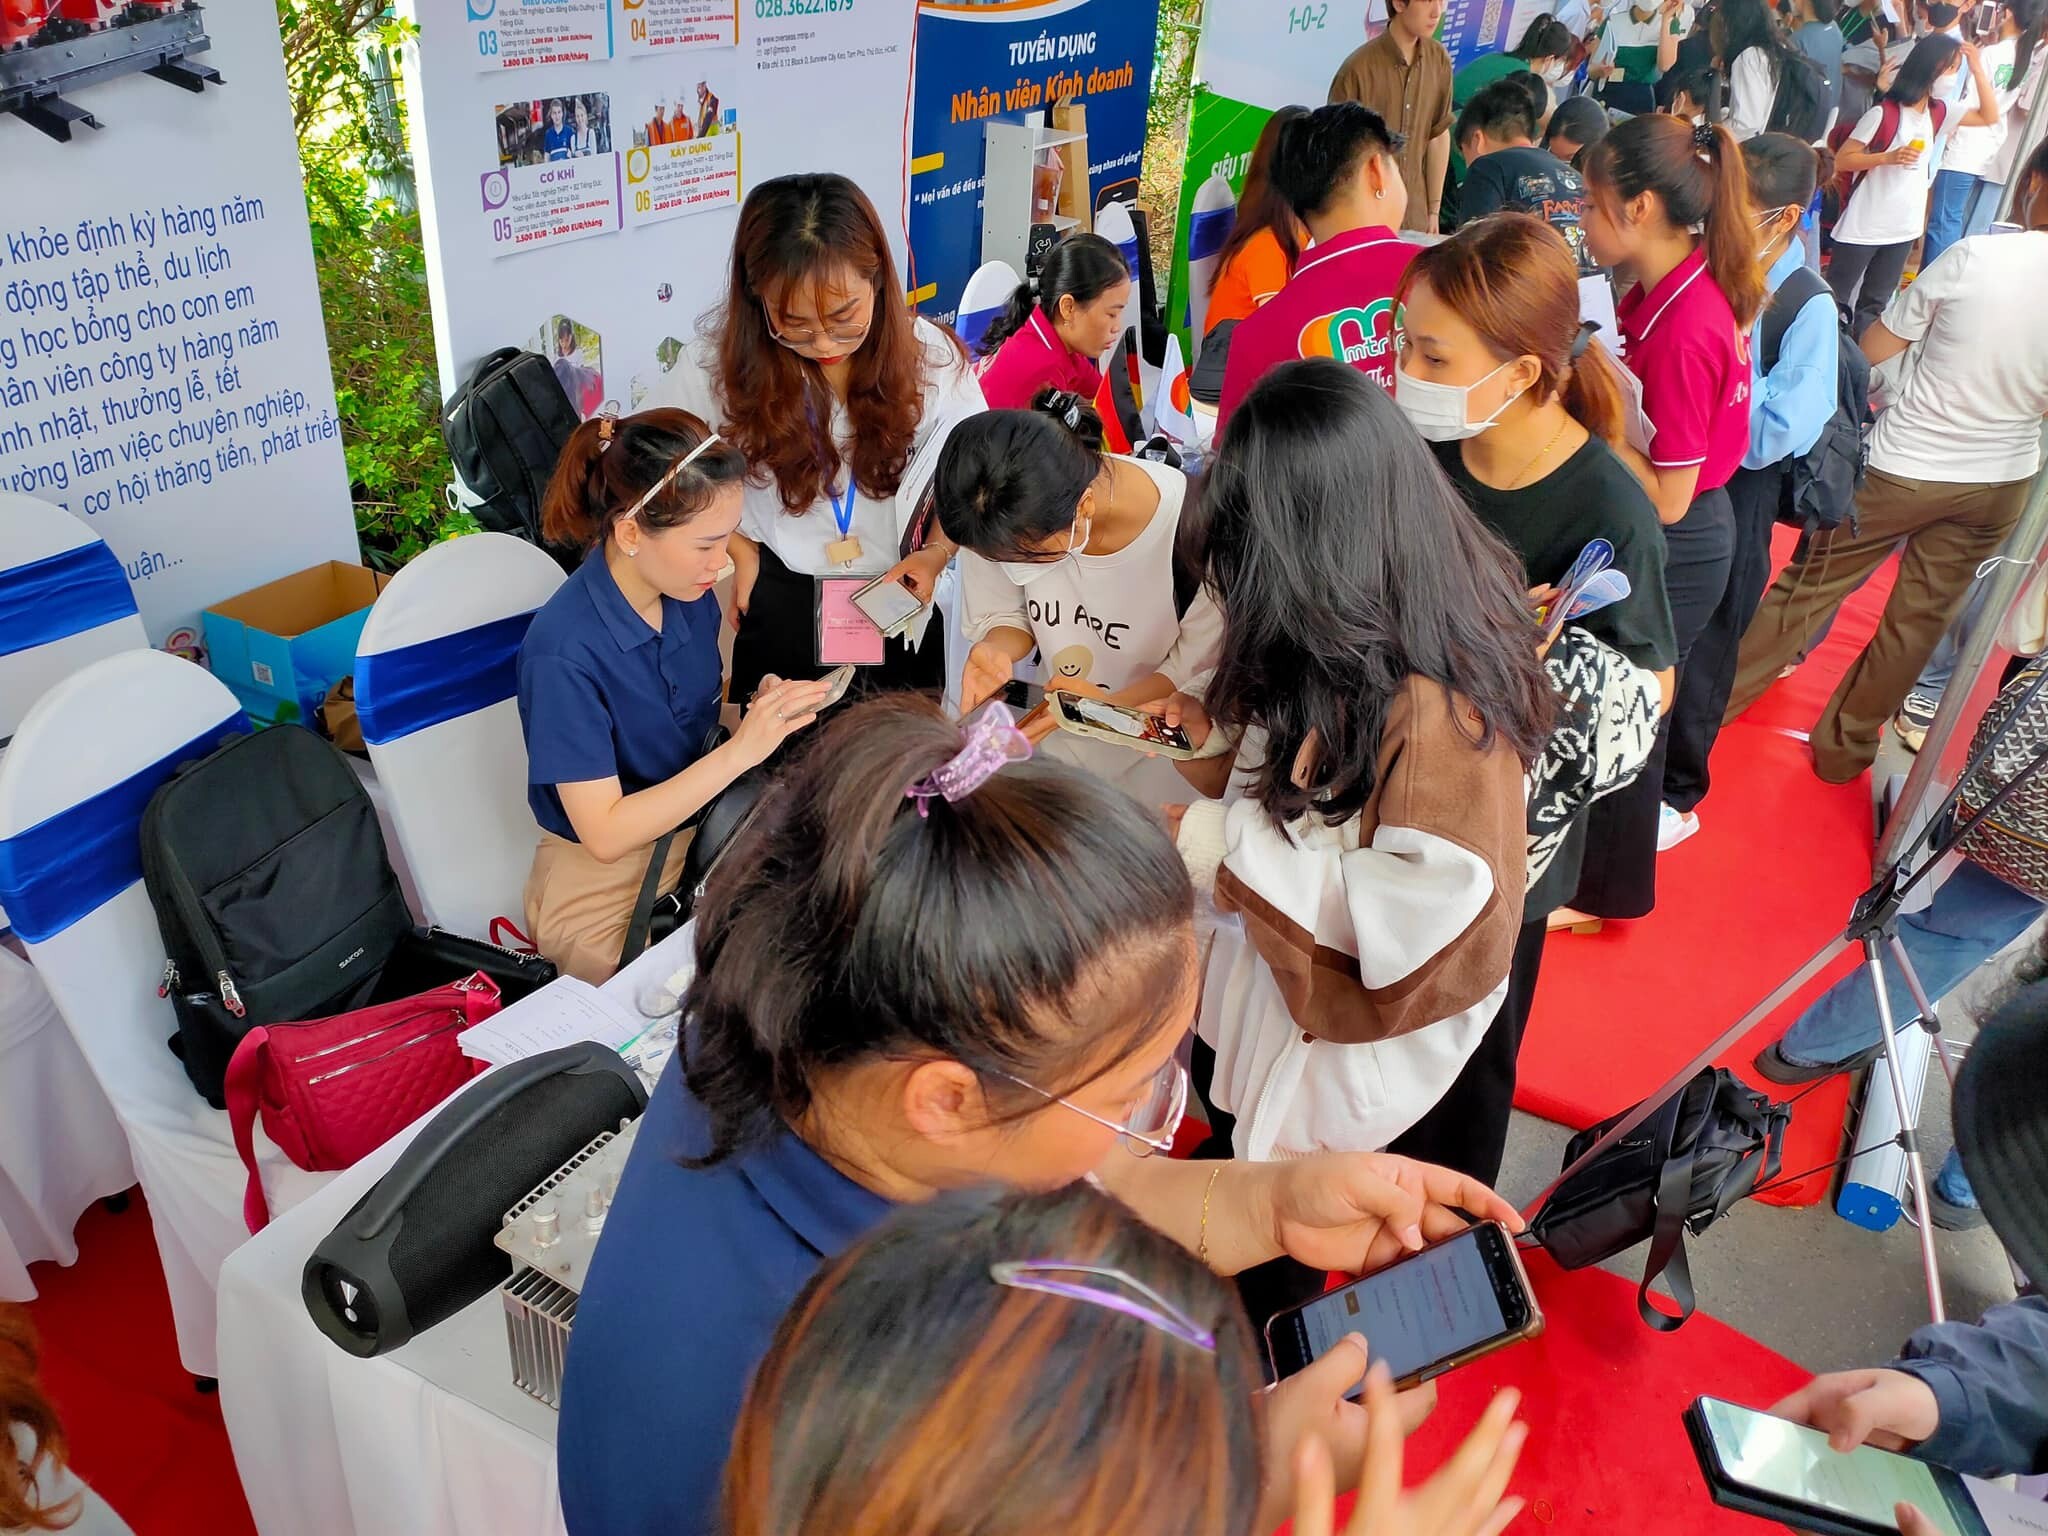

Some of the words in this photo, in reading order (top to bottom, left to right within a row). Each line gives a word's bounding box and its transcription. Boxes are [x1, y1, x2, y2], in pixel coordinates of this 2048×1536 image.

[631, 17, 647, 42] 04
[1289, 3, 1328, 34] 1-0-2
[478, 30, 498, 55] 03
[1008, 29, 1056, 66] TUYỂN
[1057, 31, 1097, 63] DỤNG
[951, 86, 1001, 124] Nhân
[1005, 78, 1041, 111] viên
[1045, 69, 1083, 104] Kinh
[1086, 60, 1134, 95] doanh
[540, 169, 555, 183] CƠ
[557, 165, 576, 181] KHÍ
[636, 190, 651, 212] 06
[7, 226, 69, 264] khỏe
[77, 217, 126, 252] định
[130, 210, 155, 248] kỳ
[162, 205, 216, 236] hàng
[221, 195, 264, 226] năm
[493, 216, 512, 242] 05
[534, 230, 547, 240] EUR
[6, 280, 68, 315] động
[72, 268, 109, 303] tập
[115, 251, 158, 290] thể,
[164, 251, 191, 280] du
[197, 242, 232, 279] lịch
[21, 328, 68, 358] học
[72, 306, 131, 345] bổng
[138, 301, 175, 330] cho
[183, 295, 219, 320] con
[225, 286, 254, 310] em
[43, 363, 93, 396] viên
[100, 352, 153, 382] công
[158, 343, 176, 374] ty
[182, 332, 233, 365] hàng
[238, 318, 279, 348] năm
[0, 421, 33, 455] nh
[39, 406, 97, 443] nhật,
[102, 387, 182, 425] thưởng
[186, 369, 211, 402] lễ,
[216, 360, 242, 394] tết
[0, 461, 69, 493] ường
[72, 448, 114, 477] làm
[119, 431, 163, 462] việc
[169, 409, 238, 450] chuyên
[244, 389, 310, 428] nghiệp,
[84, 489, 110, 515] cơ
[117, 474, 150, 504] hội
[155, 459, 212, 492] thăng
[216, 438, 256, 472] tiến,
[262, 425, 301, 464] phát
[127, 551, 183, 580] uận...
[1029, 600, 1060, 626] OU
[1074, 604, 1130, 650] ARE
